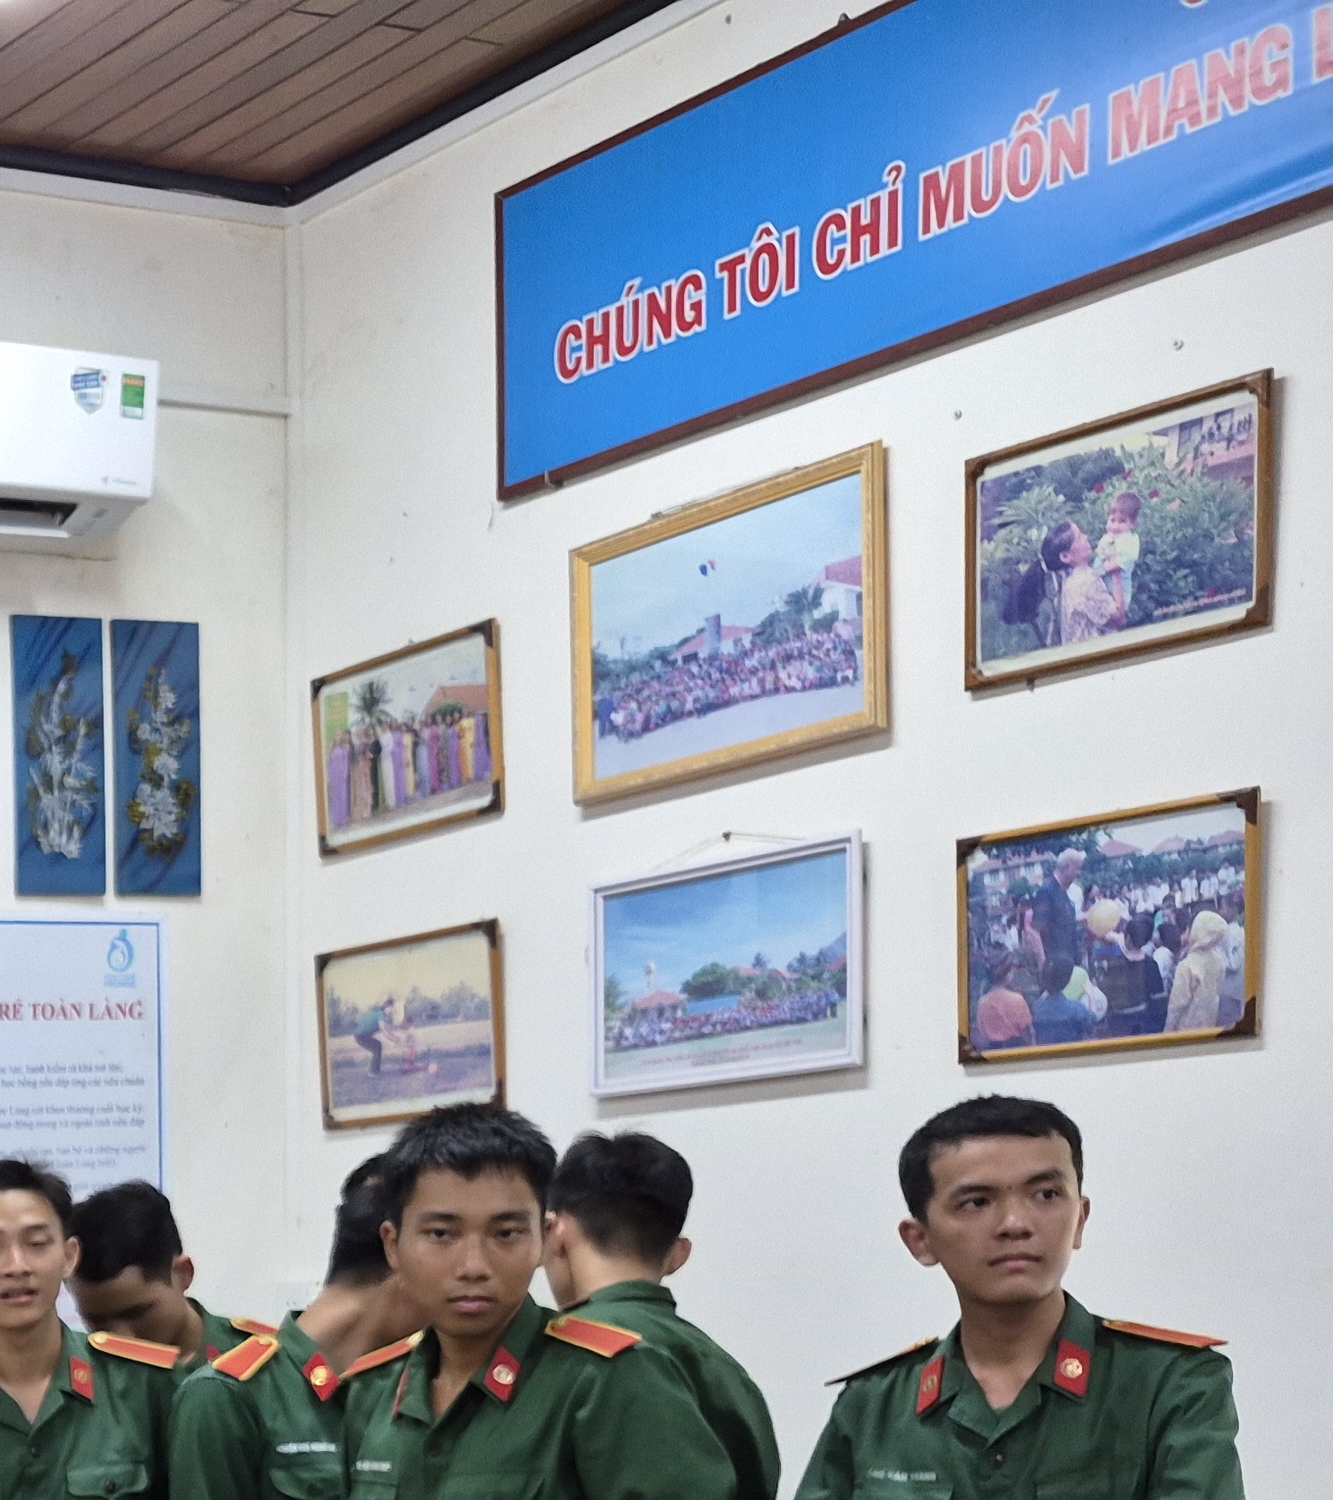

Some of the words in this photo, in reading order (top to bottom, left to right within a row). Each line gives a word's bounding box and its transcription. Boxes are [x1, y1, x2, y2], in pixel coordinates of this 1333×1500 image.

[554, 272, 708, 388] CHÚNG
[716, 221, 800, 318] TÔI
[813, 162, 906, 280] CHỈ
[918, 90, 1091, 241] MUỐN
[1108, 23, 1293, 165] MANG
[31, 998, 83, 1021] TOÀN
[88, 997, 145, 1021] LÀNG
